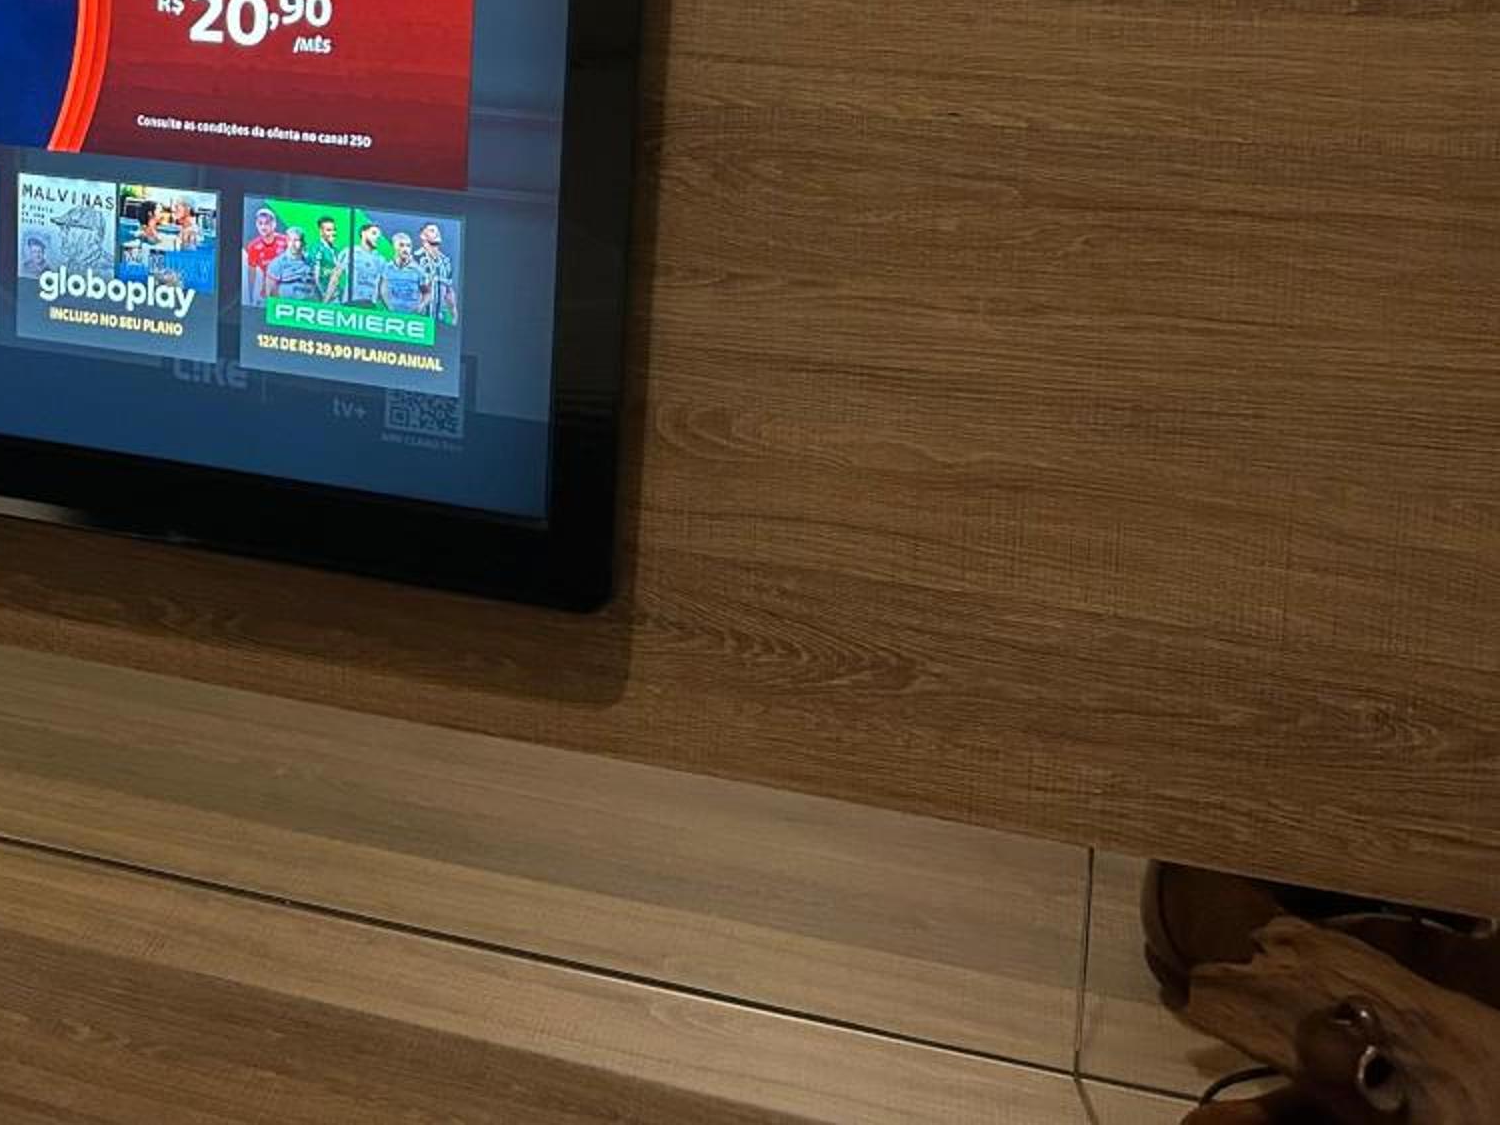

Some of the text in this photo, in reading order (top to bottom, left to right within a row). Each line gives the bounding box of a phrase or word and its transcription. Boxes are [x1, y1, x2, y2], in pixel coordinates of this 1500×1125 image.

[137, 114, 371, 148] Consulte as condições da oferta no canal 250
[22, 183, 114, 210] MALVINAS
[39, 266, 196, 318] globoplay
[49, 306, 184, 336] INCLUSO NO SEU PLANO
[275, 304, 425, 339] PREMIERE
[257, 334, 444, 372] 12X DE R$ 29,90 PLANO ANUAL
